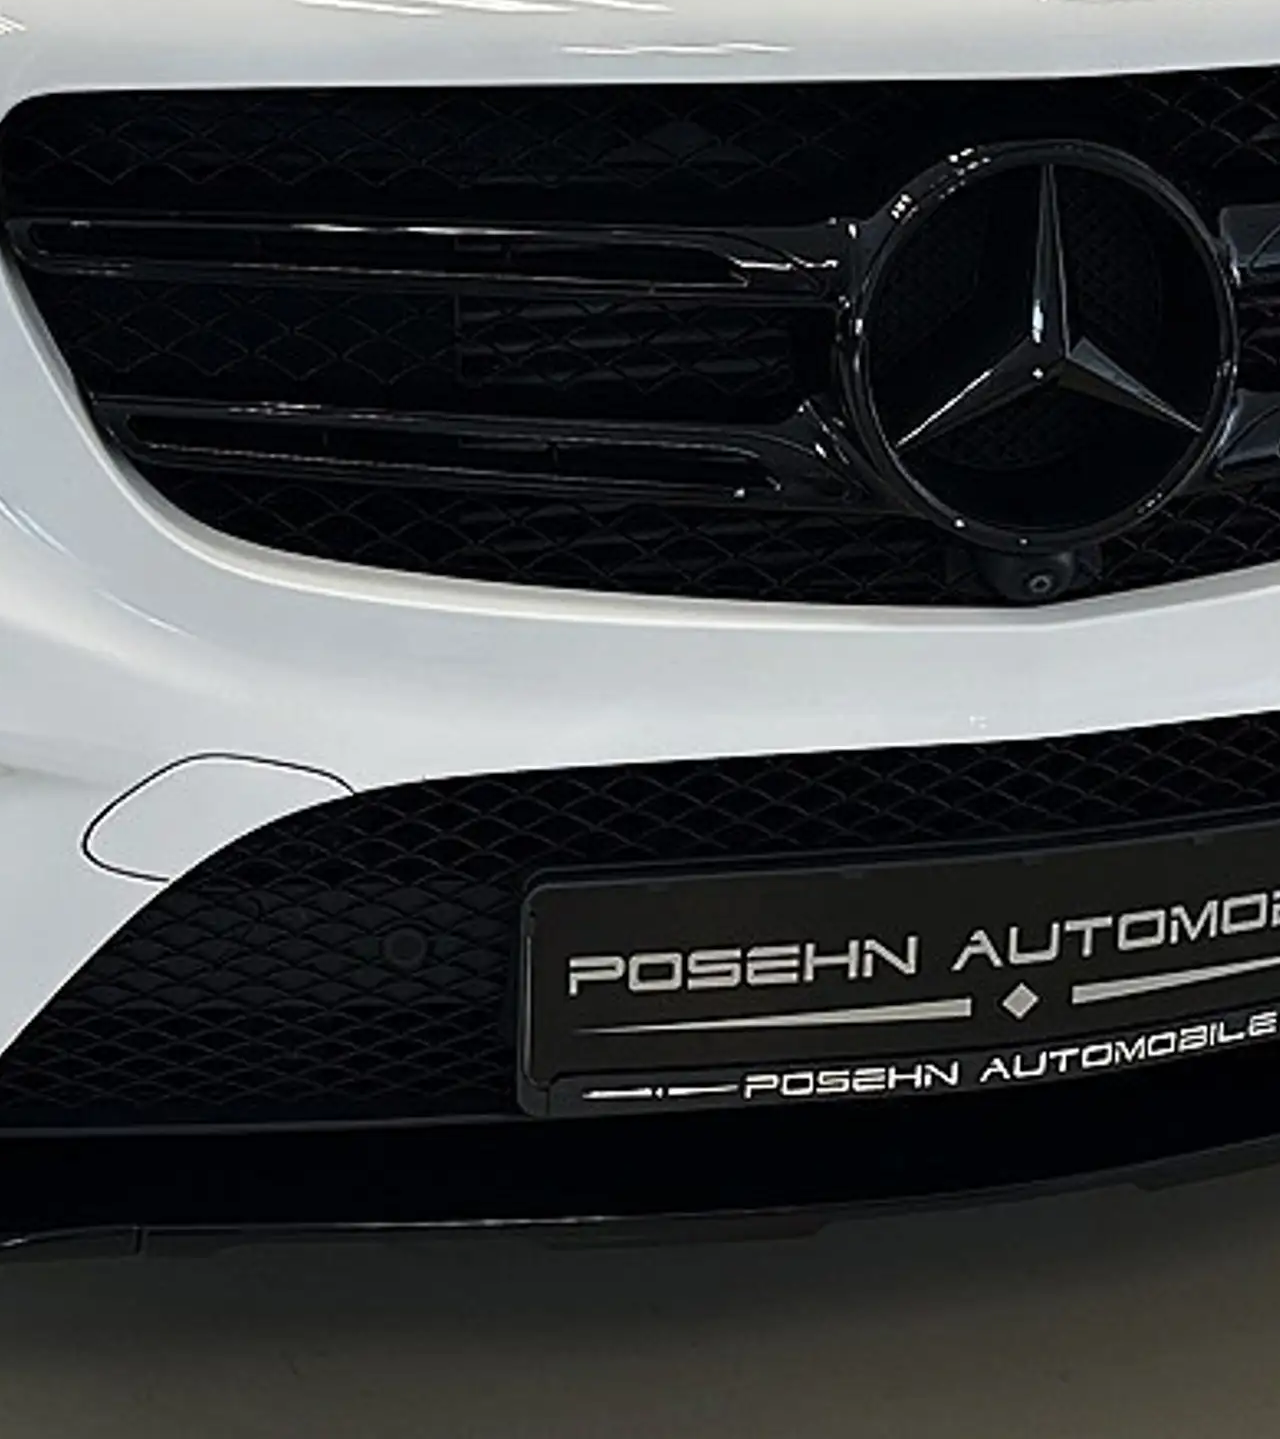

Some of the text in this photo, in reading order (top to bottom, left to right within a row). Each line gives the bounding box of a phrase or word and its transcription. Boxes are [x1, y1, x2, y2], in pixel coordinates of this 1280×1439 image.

[569, 935, 918, 995] POSEHN
[743, 1011, 1279, 1100] POSEHN AUTOMOBILE
